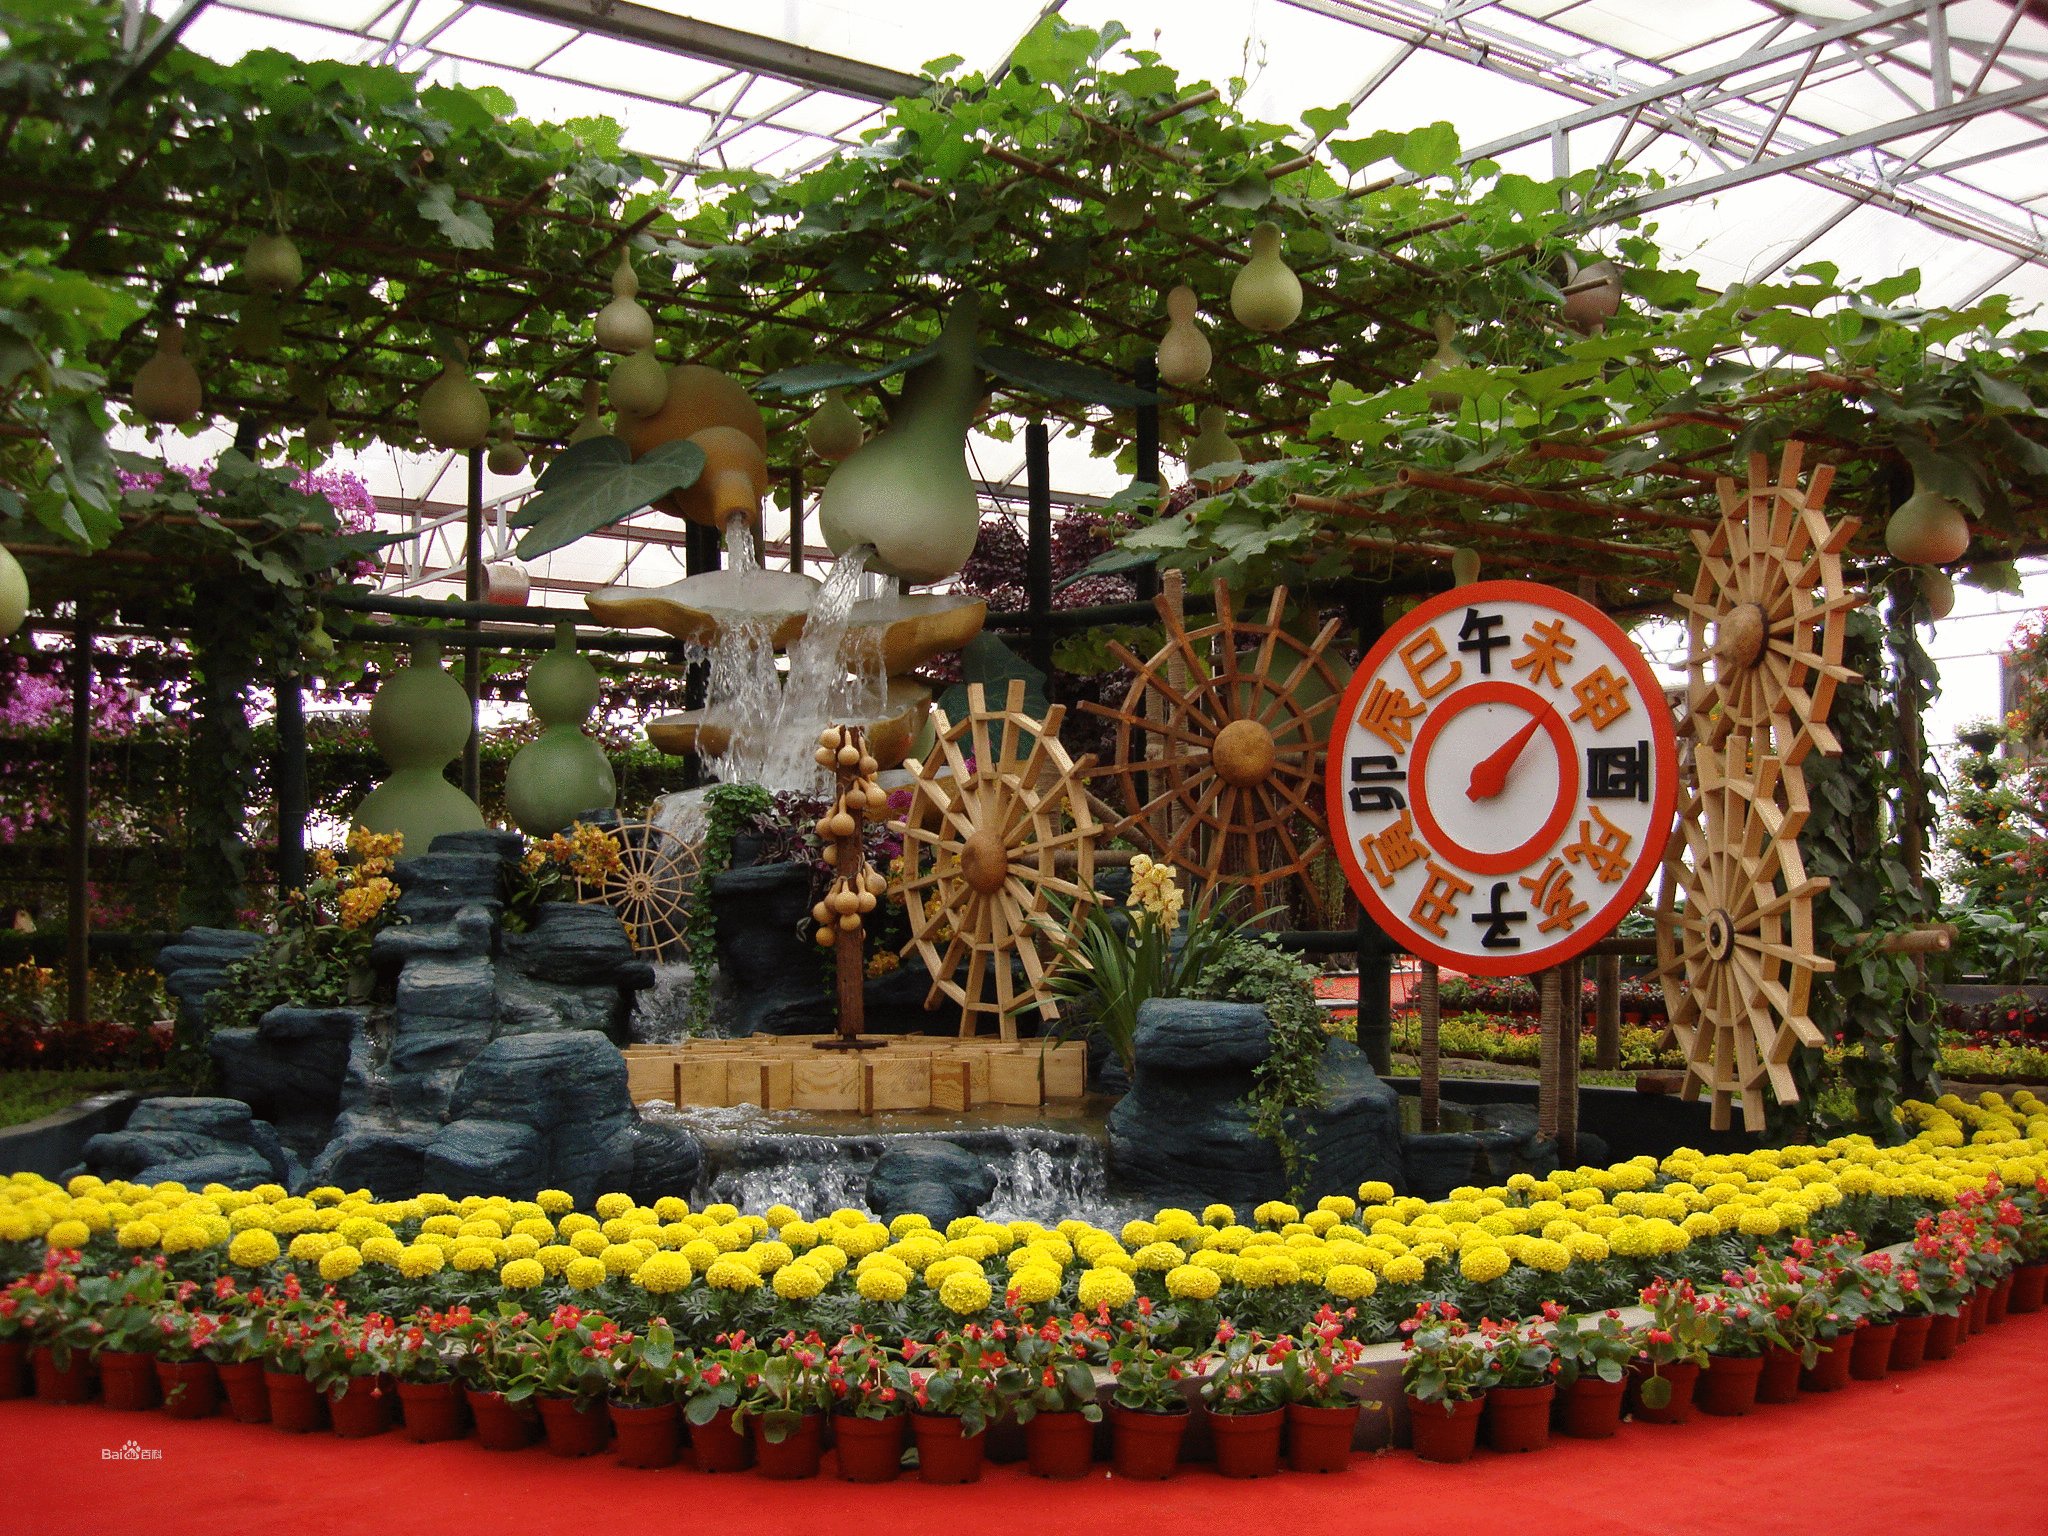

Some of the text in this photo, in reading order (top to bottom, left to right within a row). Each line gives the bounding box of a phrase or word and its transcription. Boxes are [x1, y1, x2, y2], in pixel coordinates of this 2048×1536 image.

[1458, 607, 1510, 674] 午
[1511, 618, 1576, 688] 未
[1356, 678, 1427, 755] 辰
[1568, 664, 1631, 731] 申
[1348, 755, 1407, 812] 卯
[1587, 740, 1649, 802] 酉
[1359, 809, 1431, 888] 寅
[1563, 805, 1632, 883] 戌
[1408, 860, 1474, 938] 丑
[1472, 882, 1527, 947] 子
[1519, 857, 1590, 933] 亥
